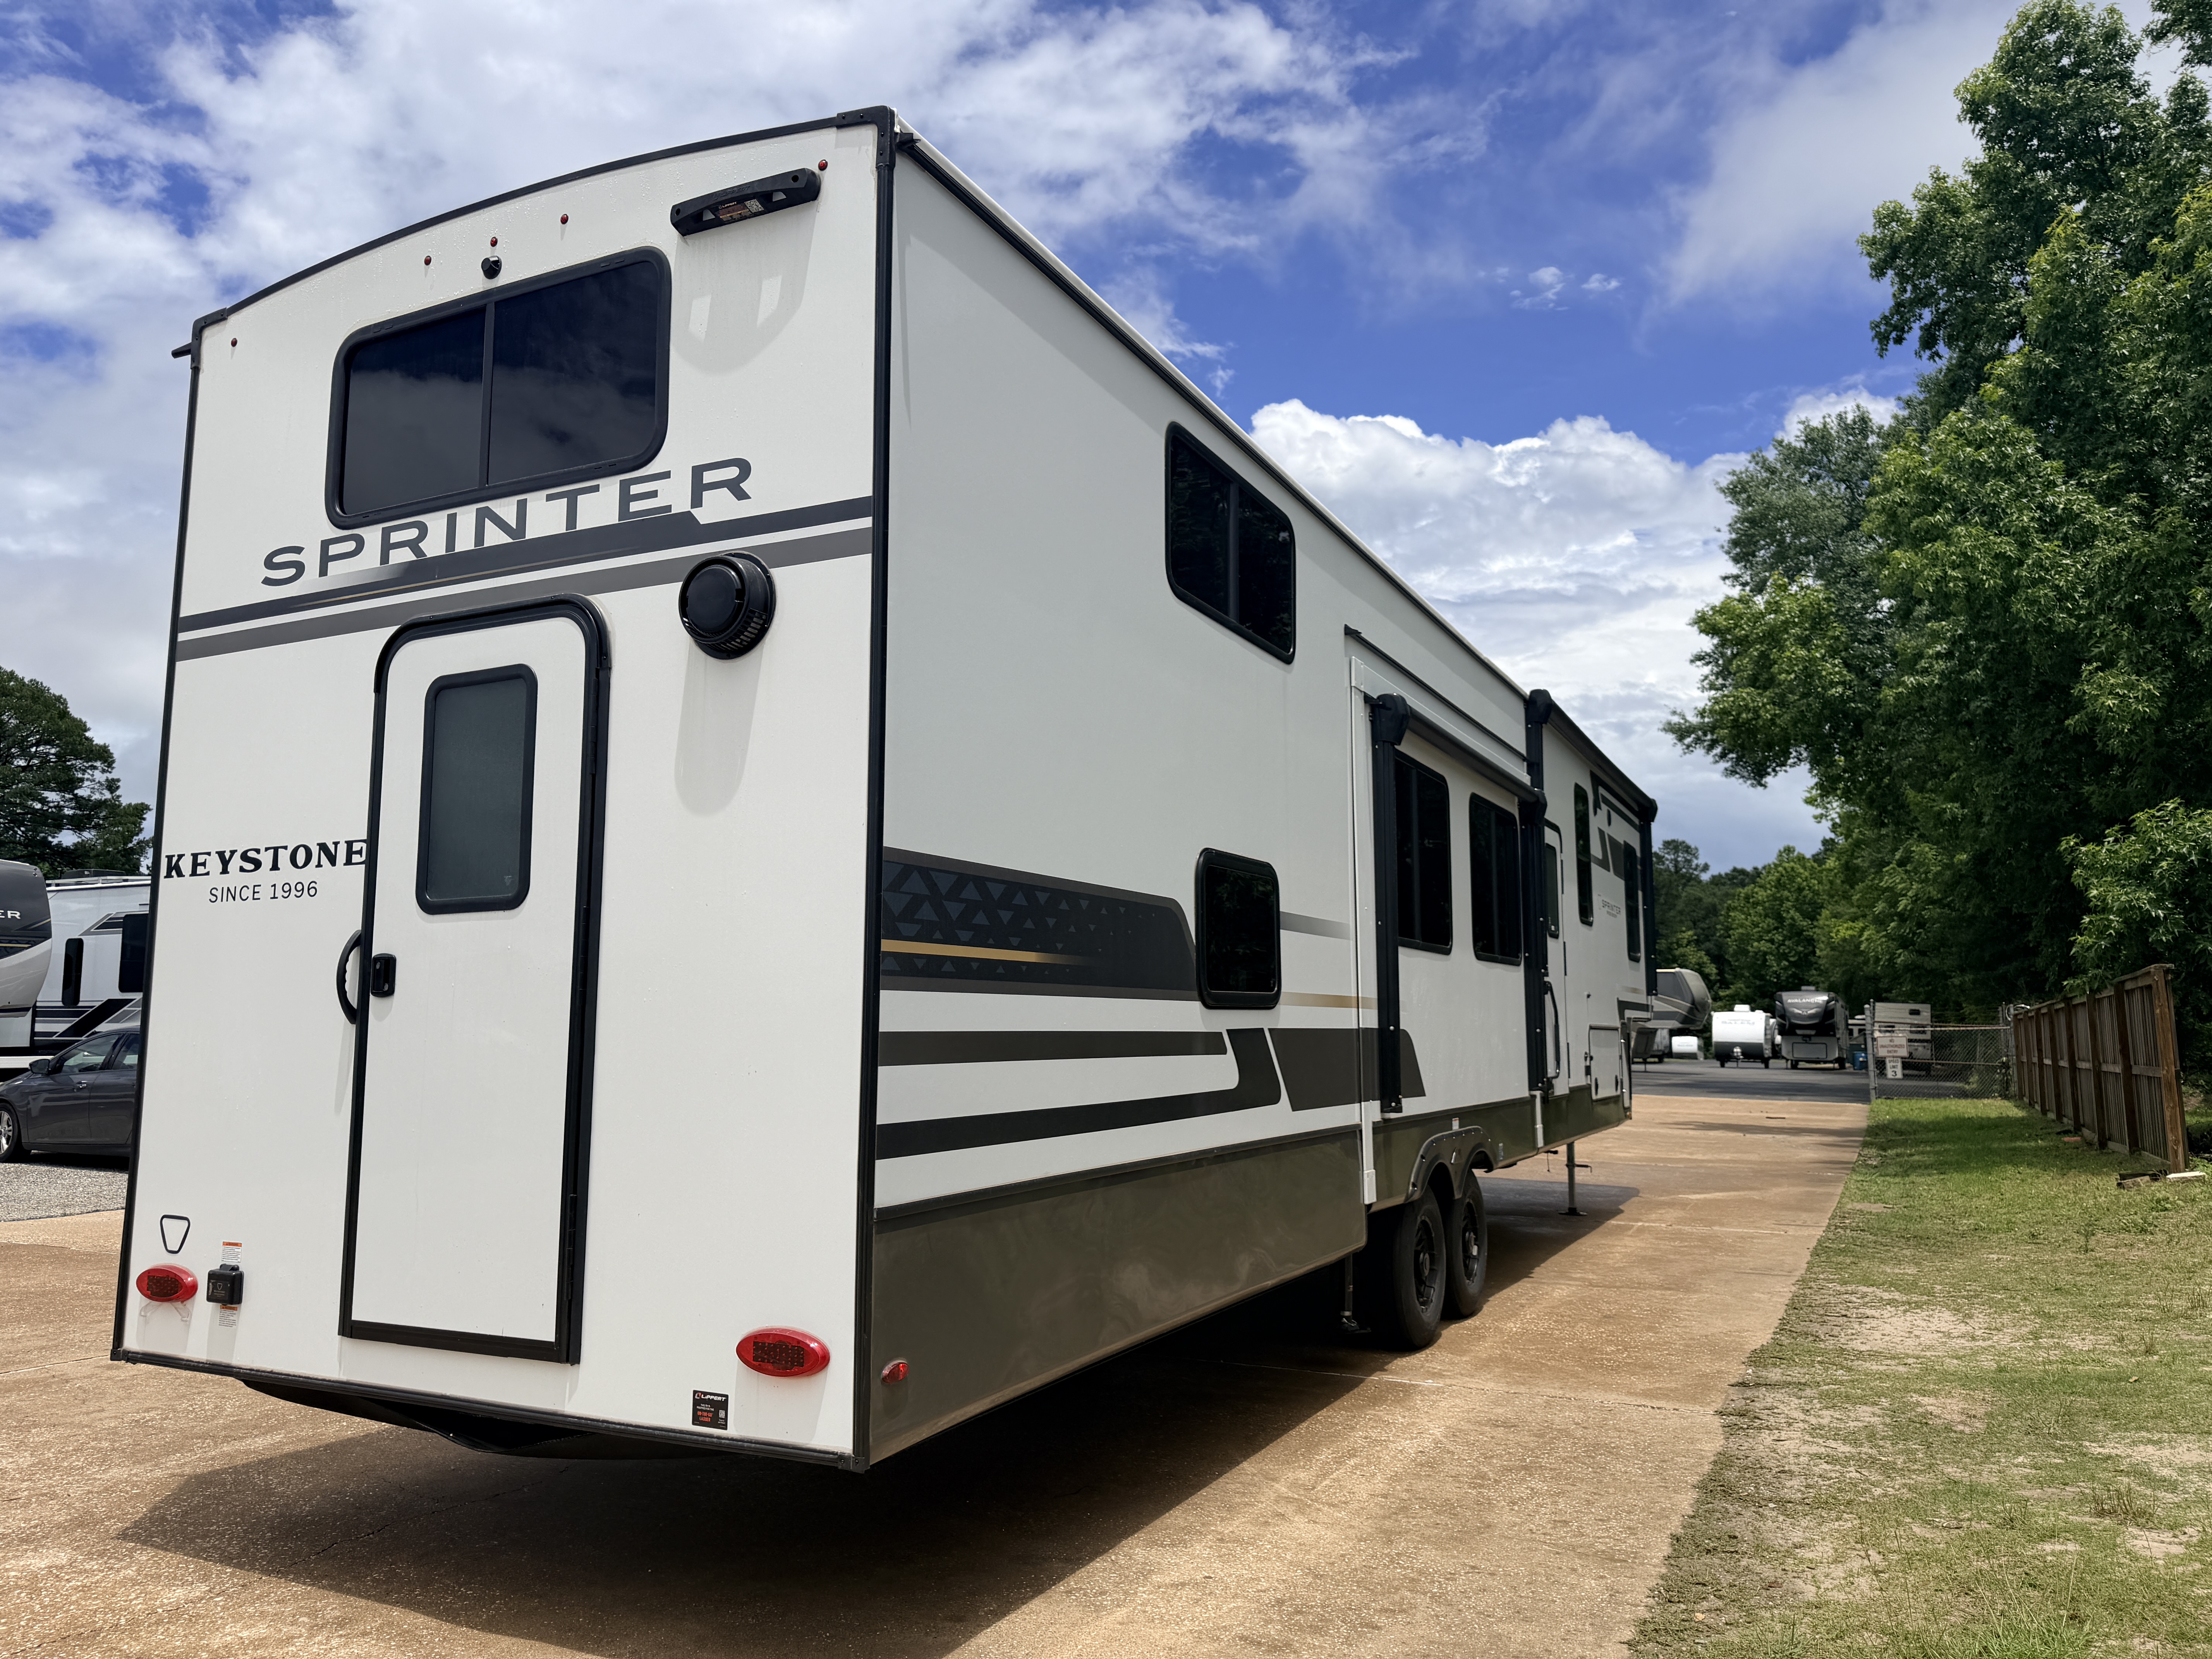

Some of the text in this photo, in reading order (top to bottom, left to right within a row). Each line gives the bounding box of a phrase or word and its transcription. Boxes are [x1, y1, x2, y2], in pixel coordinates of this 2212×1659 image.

[260, 457, 752, 587] SPRINTER
[163, 839, 368, 879] KEYSTONE
[209, 881, 318, 903] SINCE 1996
